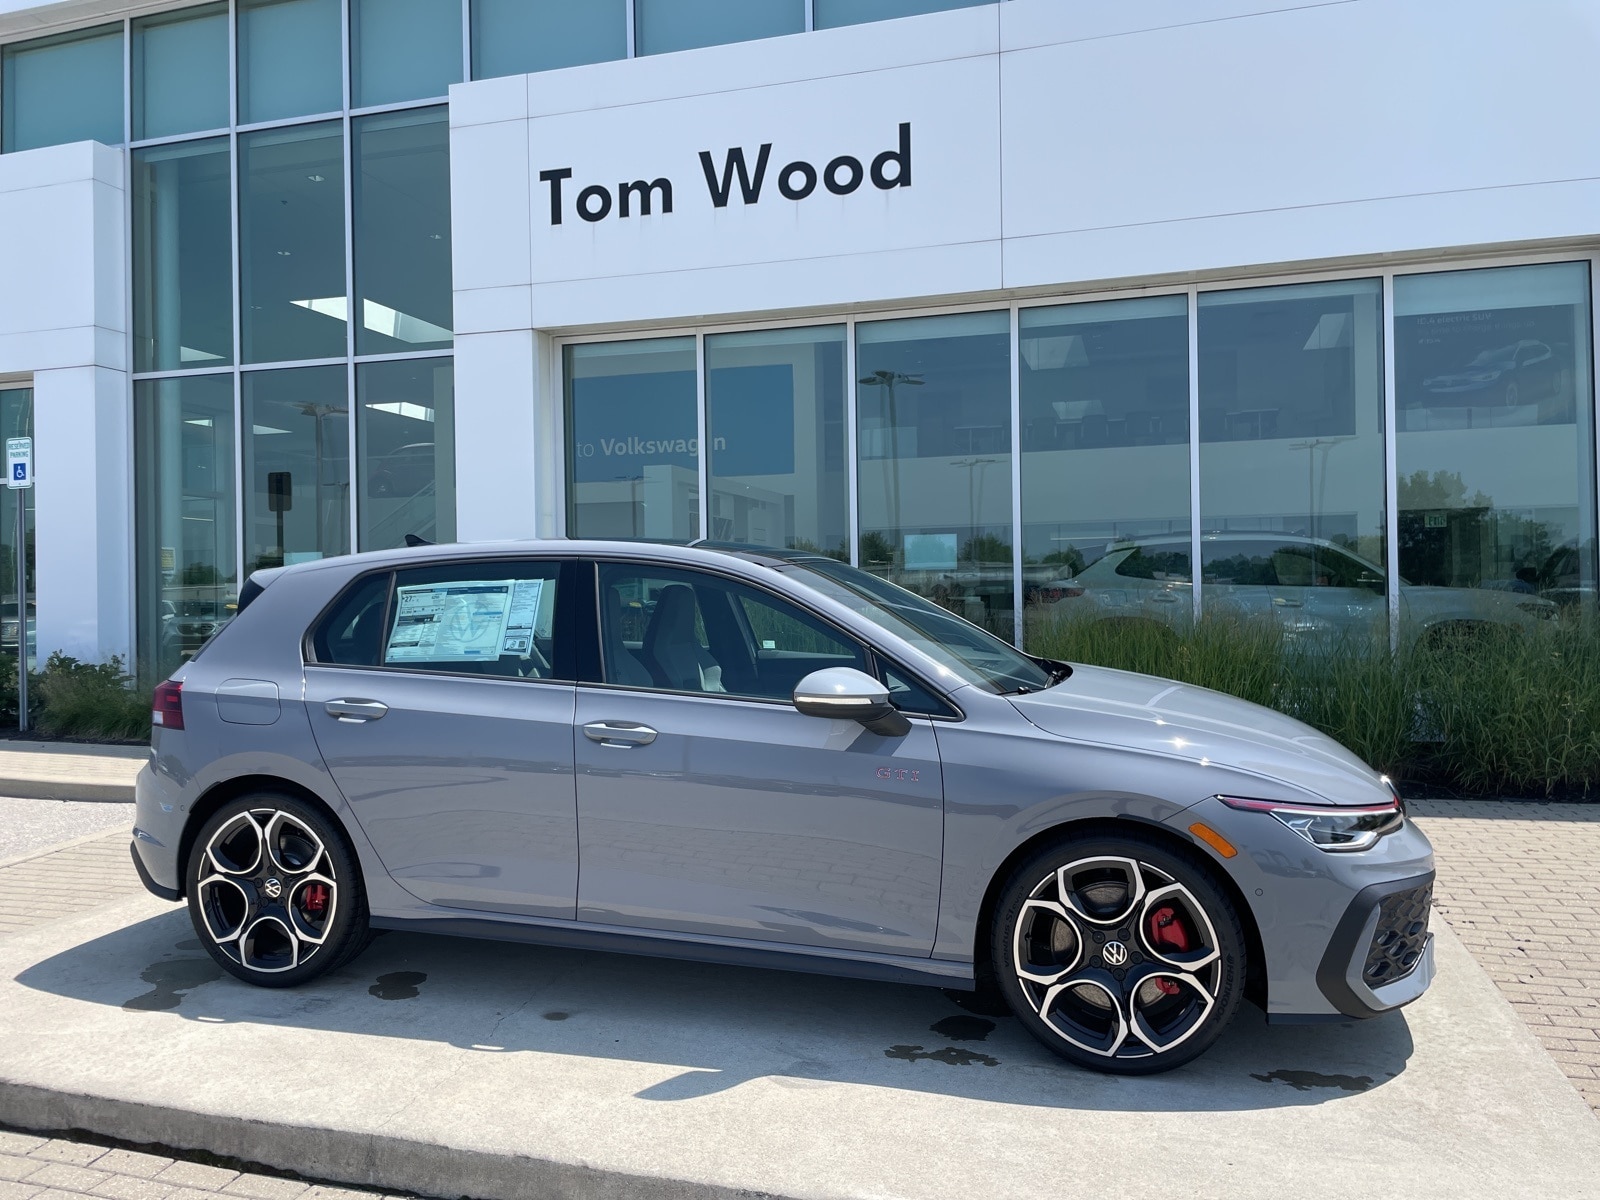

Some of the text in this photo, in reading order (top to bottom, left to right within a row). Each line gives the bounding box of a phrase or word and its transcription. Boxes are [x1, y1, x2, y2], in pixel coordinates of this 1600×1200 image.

[539, 122, 912, 225] Tom Wood
[576, 437, 726, 458] to Volkswagn
[876, 767, 920, 782] GTI
